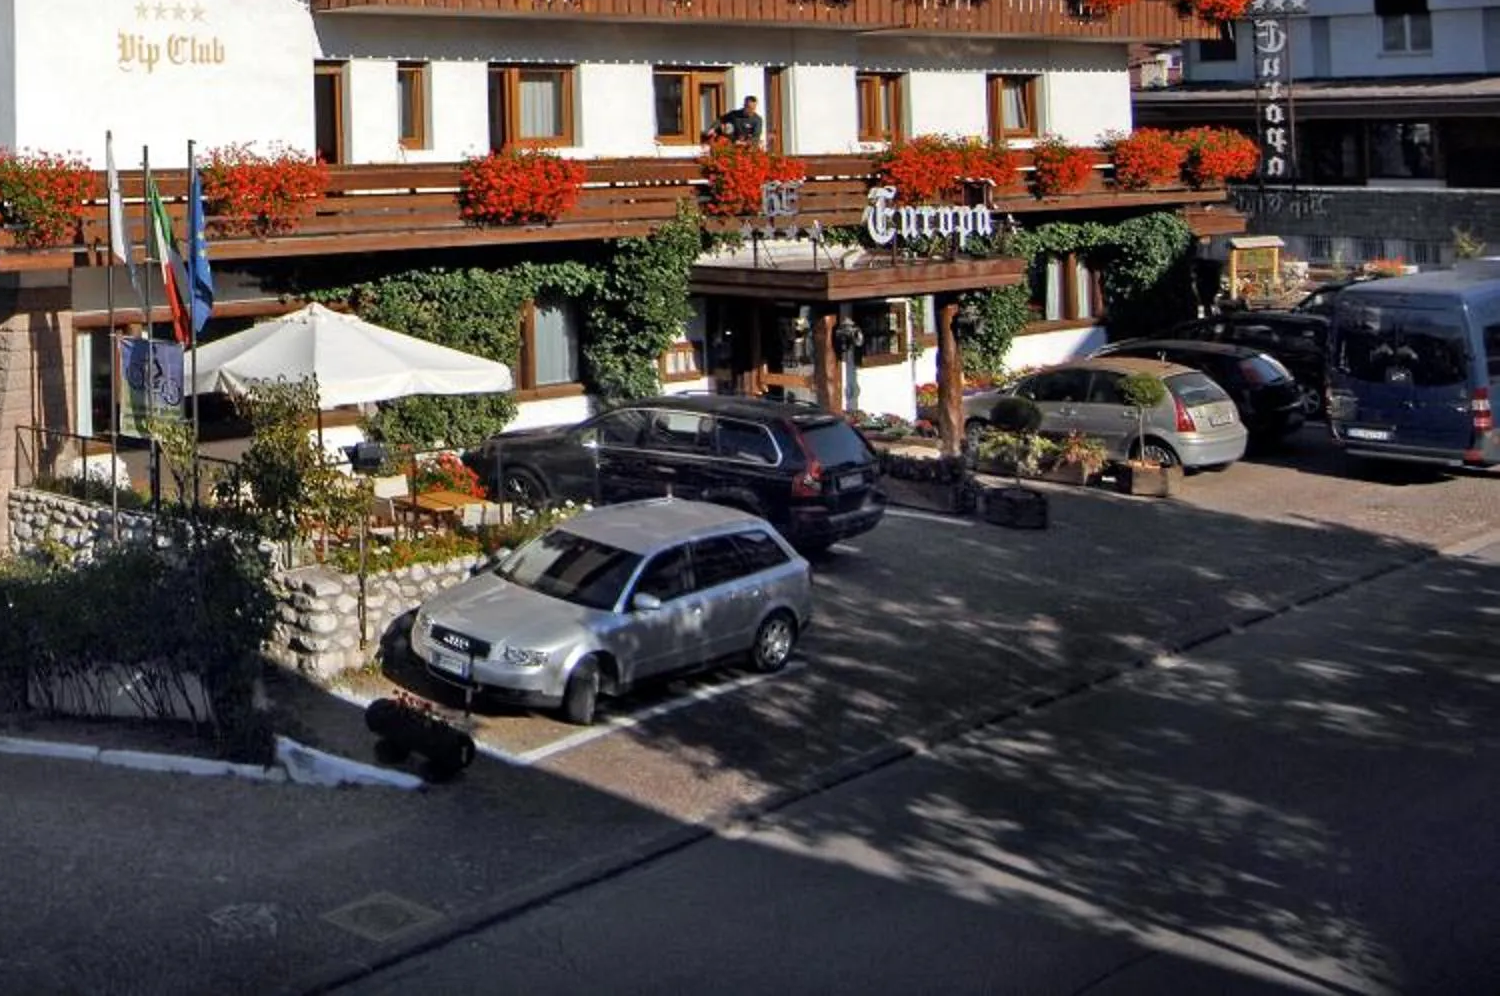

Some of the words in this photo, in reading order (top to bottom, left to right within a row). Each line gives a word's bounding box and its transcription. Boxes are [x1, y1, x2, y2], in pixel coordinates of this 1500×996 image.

[117, 28, 161, 74] Vip
[166, 34, 225, 65] Club
[865, 185, 994, 250] Europa
